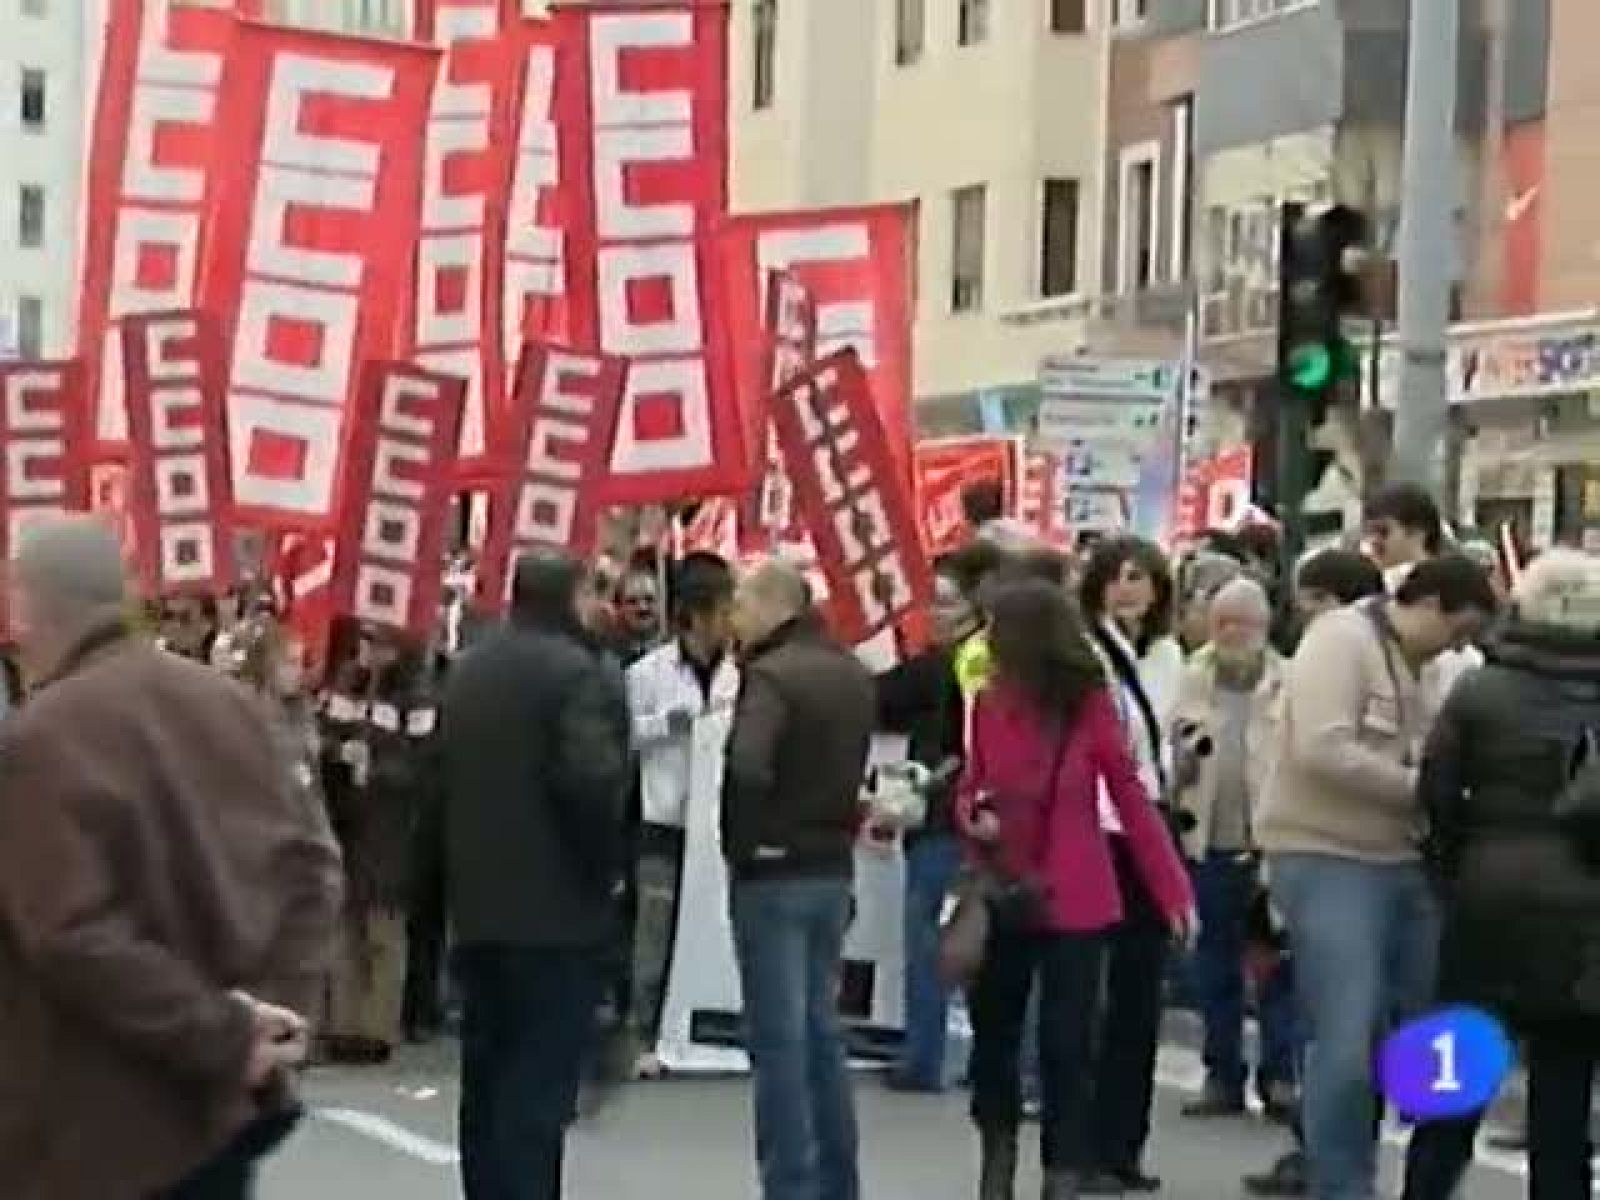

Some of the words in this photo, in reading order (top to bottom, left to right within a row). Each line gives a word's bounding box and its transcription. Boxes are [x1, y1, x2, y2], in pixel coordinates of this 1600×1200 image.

[97, 0, 233, 440] CCO
[226, 50, 396, 515] CCOO
[590, 13, 713, 473] CCOO
[147, 319, 214, 582] CCOO
[354, 374, 440, 626] CCOO
